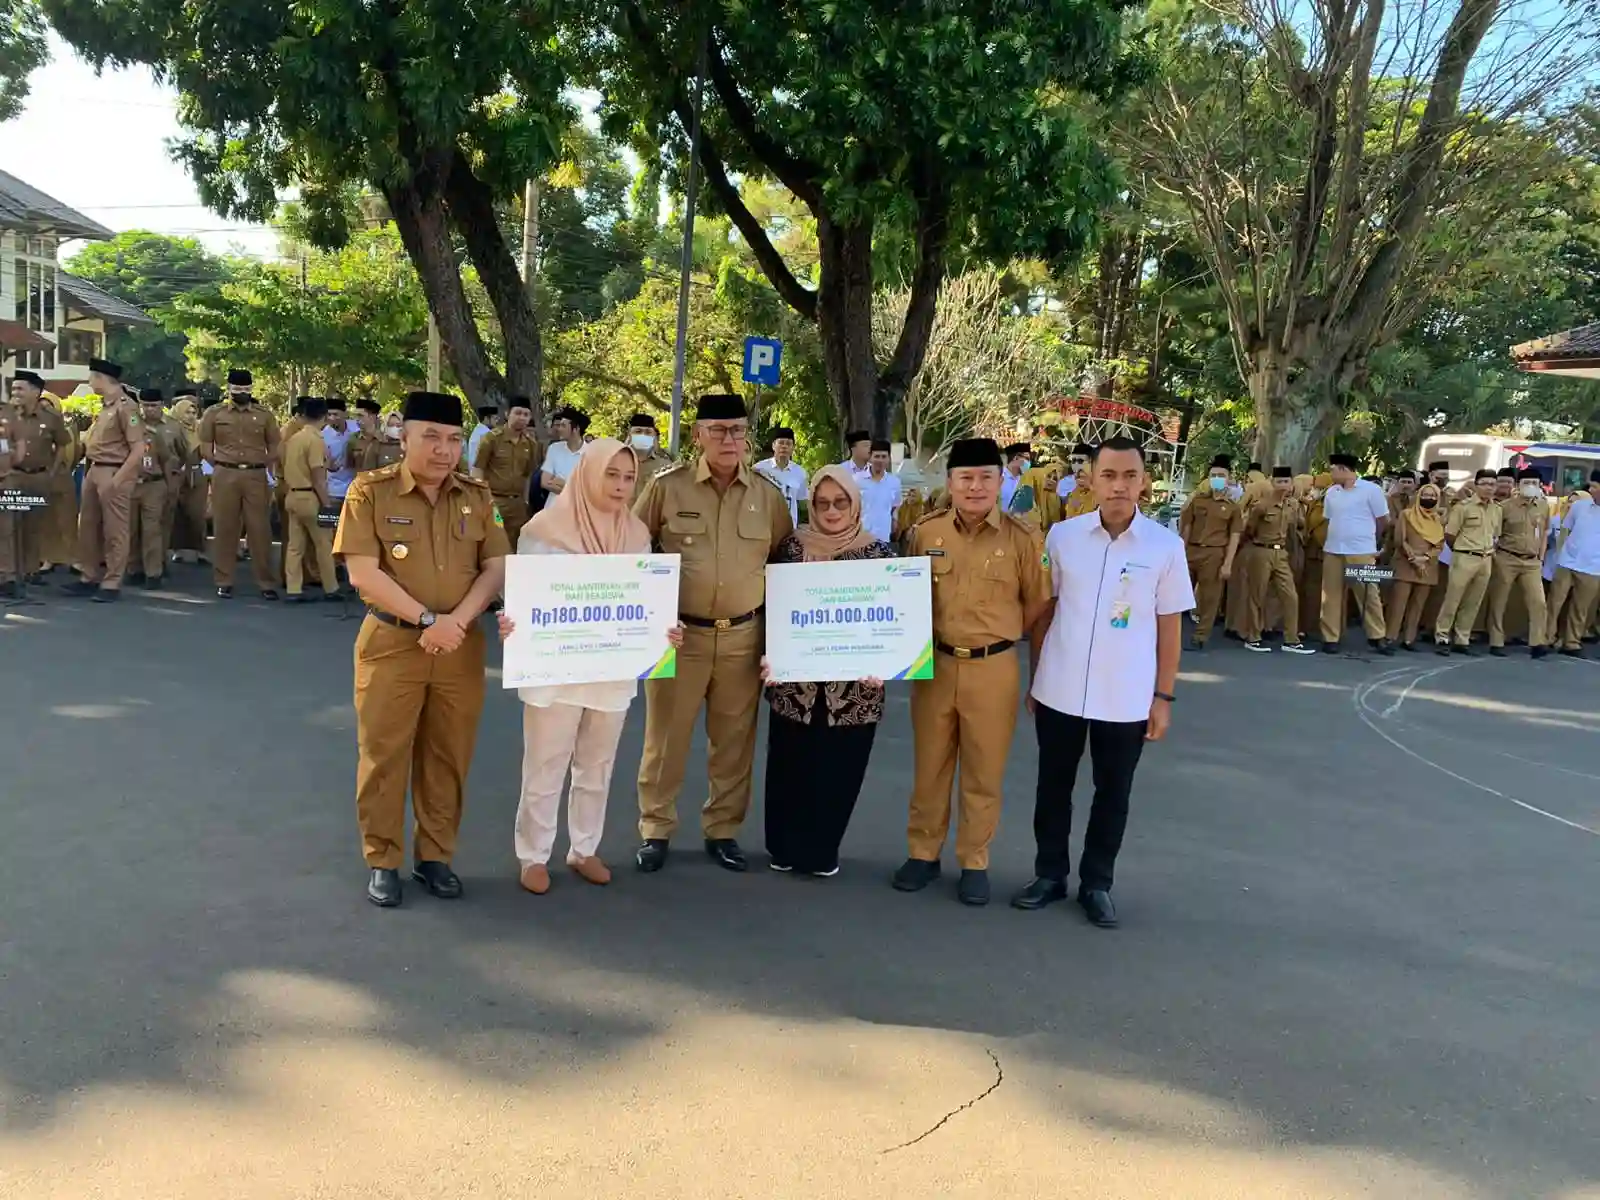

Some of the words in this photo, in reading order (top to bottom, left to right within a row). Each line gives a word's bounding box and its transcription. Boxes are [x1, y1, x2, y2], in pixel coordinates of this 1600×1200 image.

[750, 344, 774, 375] P
[531, 604, 655, 627] Rp180.000.000,-
[791, 606, 905, 628] Rp191.000.000,-
